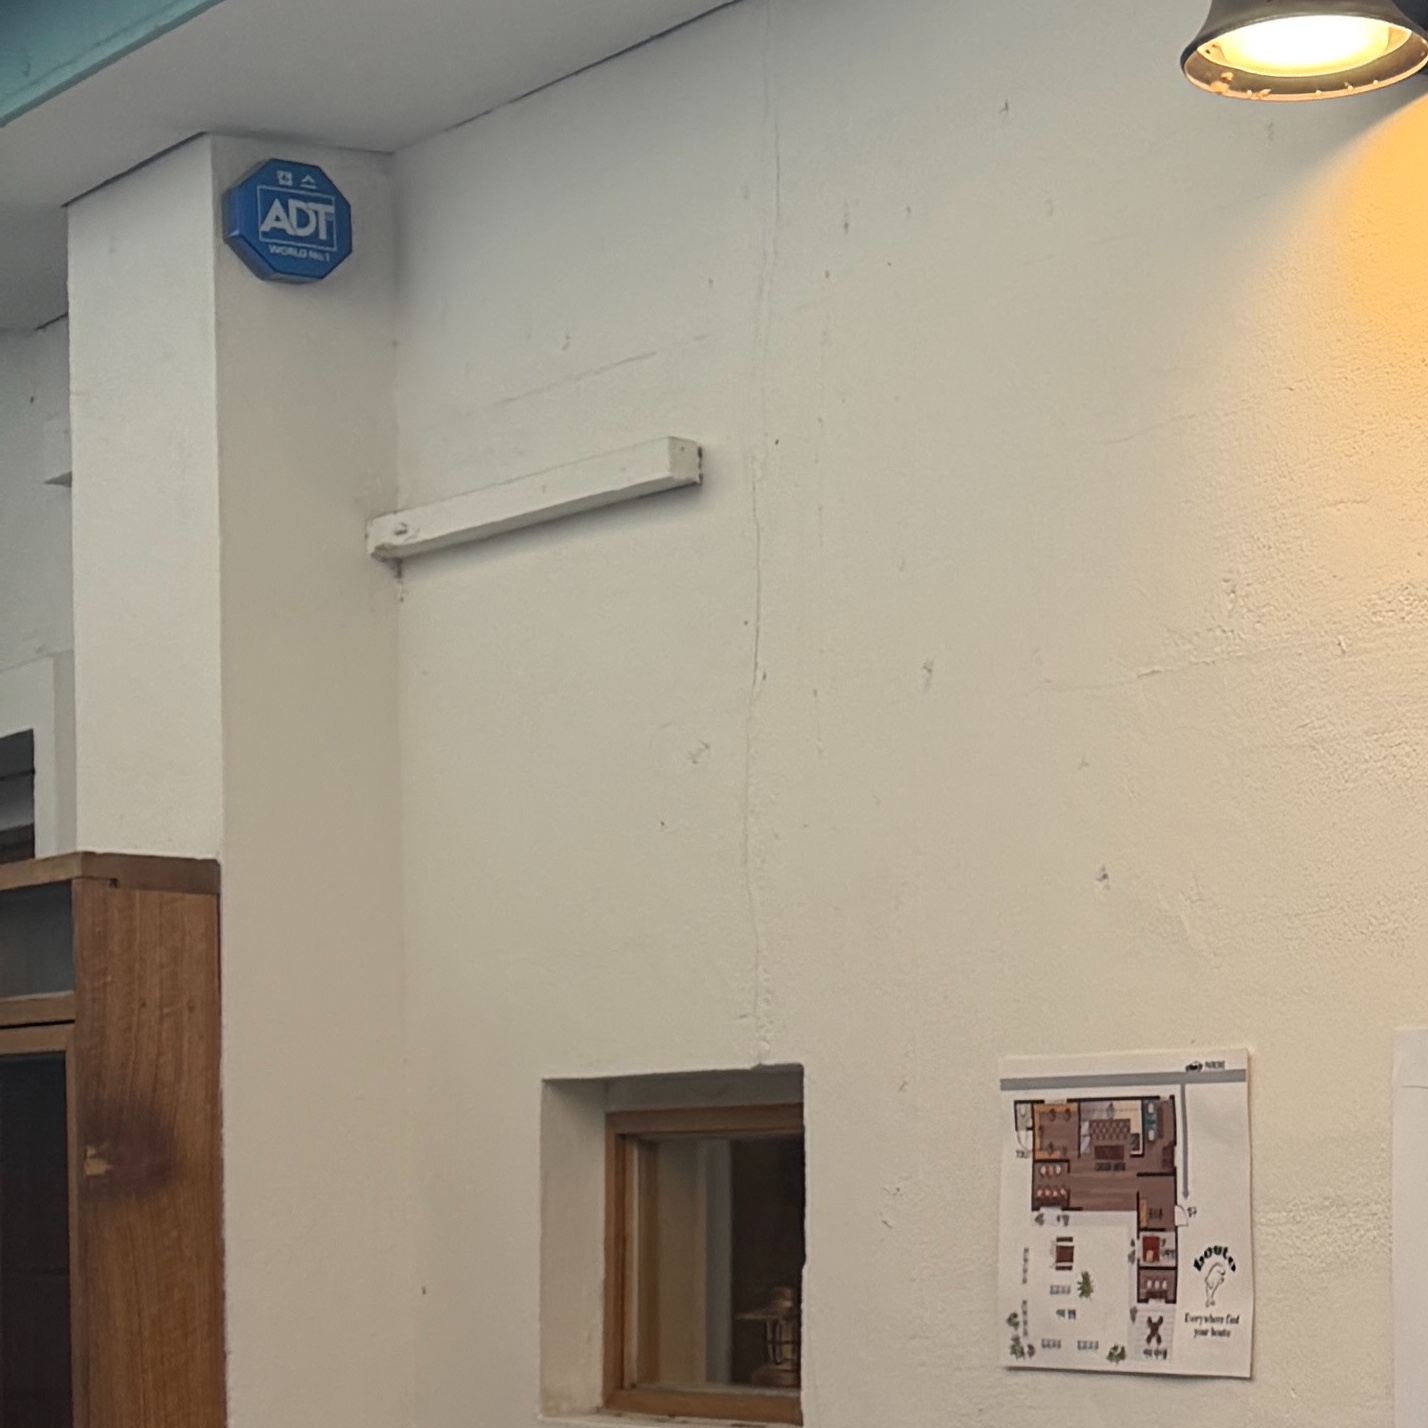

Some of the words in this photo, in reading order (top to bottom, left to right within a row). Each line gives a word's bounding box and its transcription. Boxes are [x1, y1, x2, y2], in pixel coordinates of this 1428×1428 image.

[260, 198, 335, 241] ADT
[268, 244, 307, 259] WORLD
[1193, 1244, 1237, 1273] bouto
